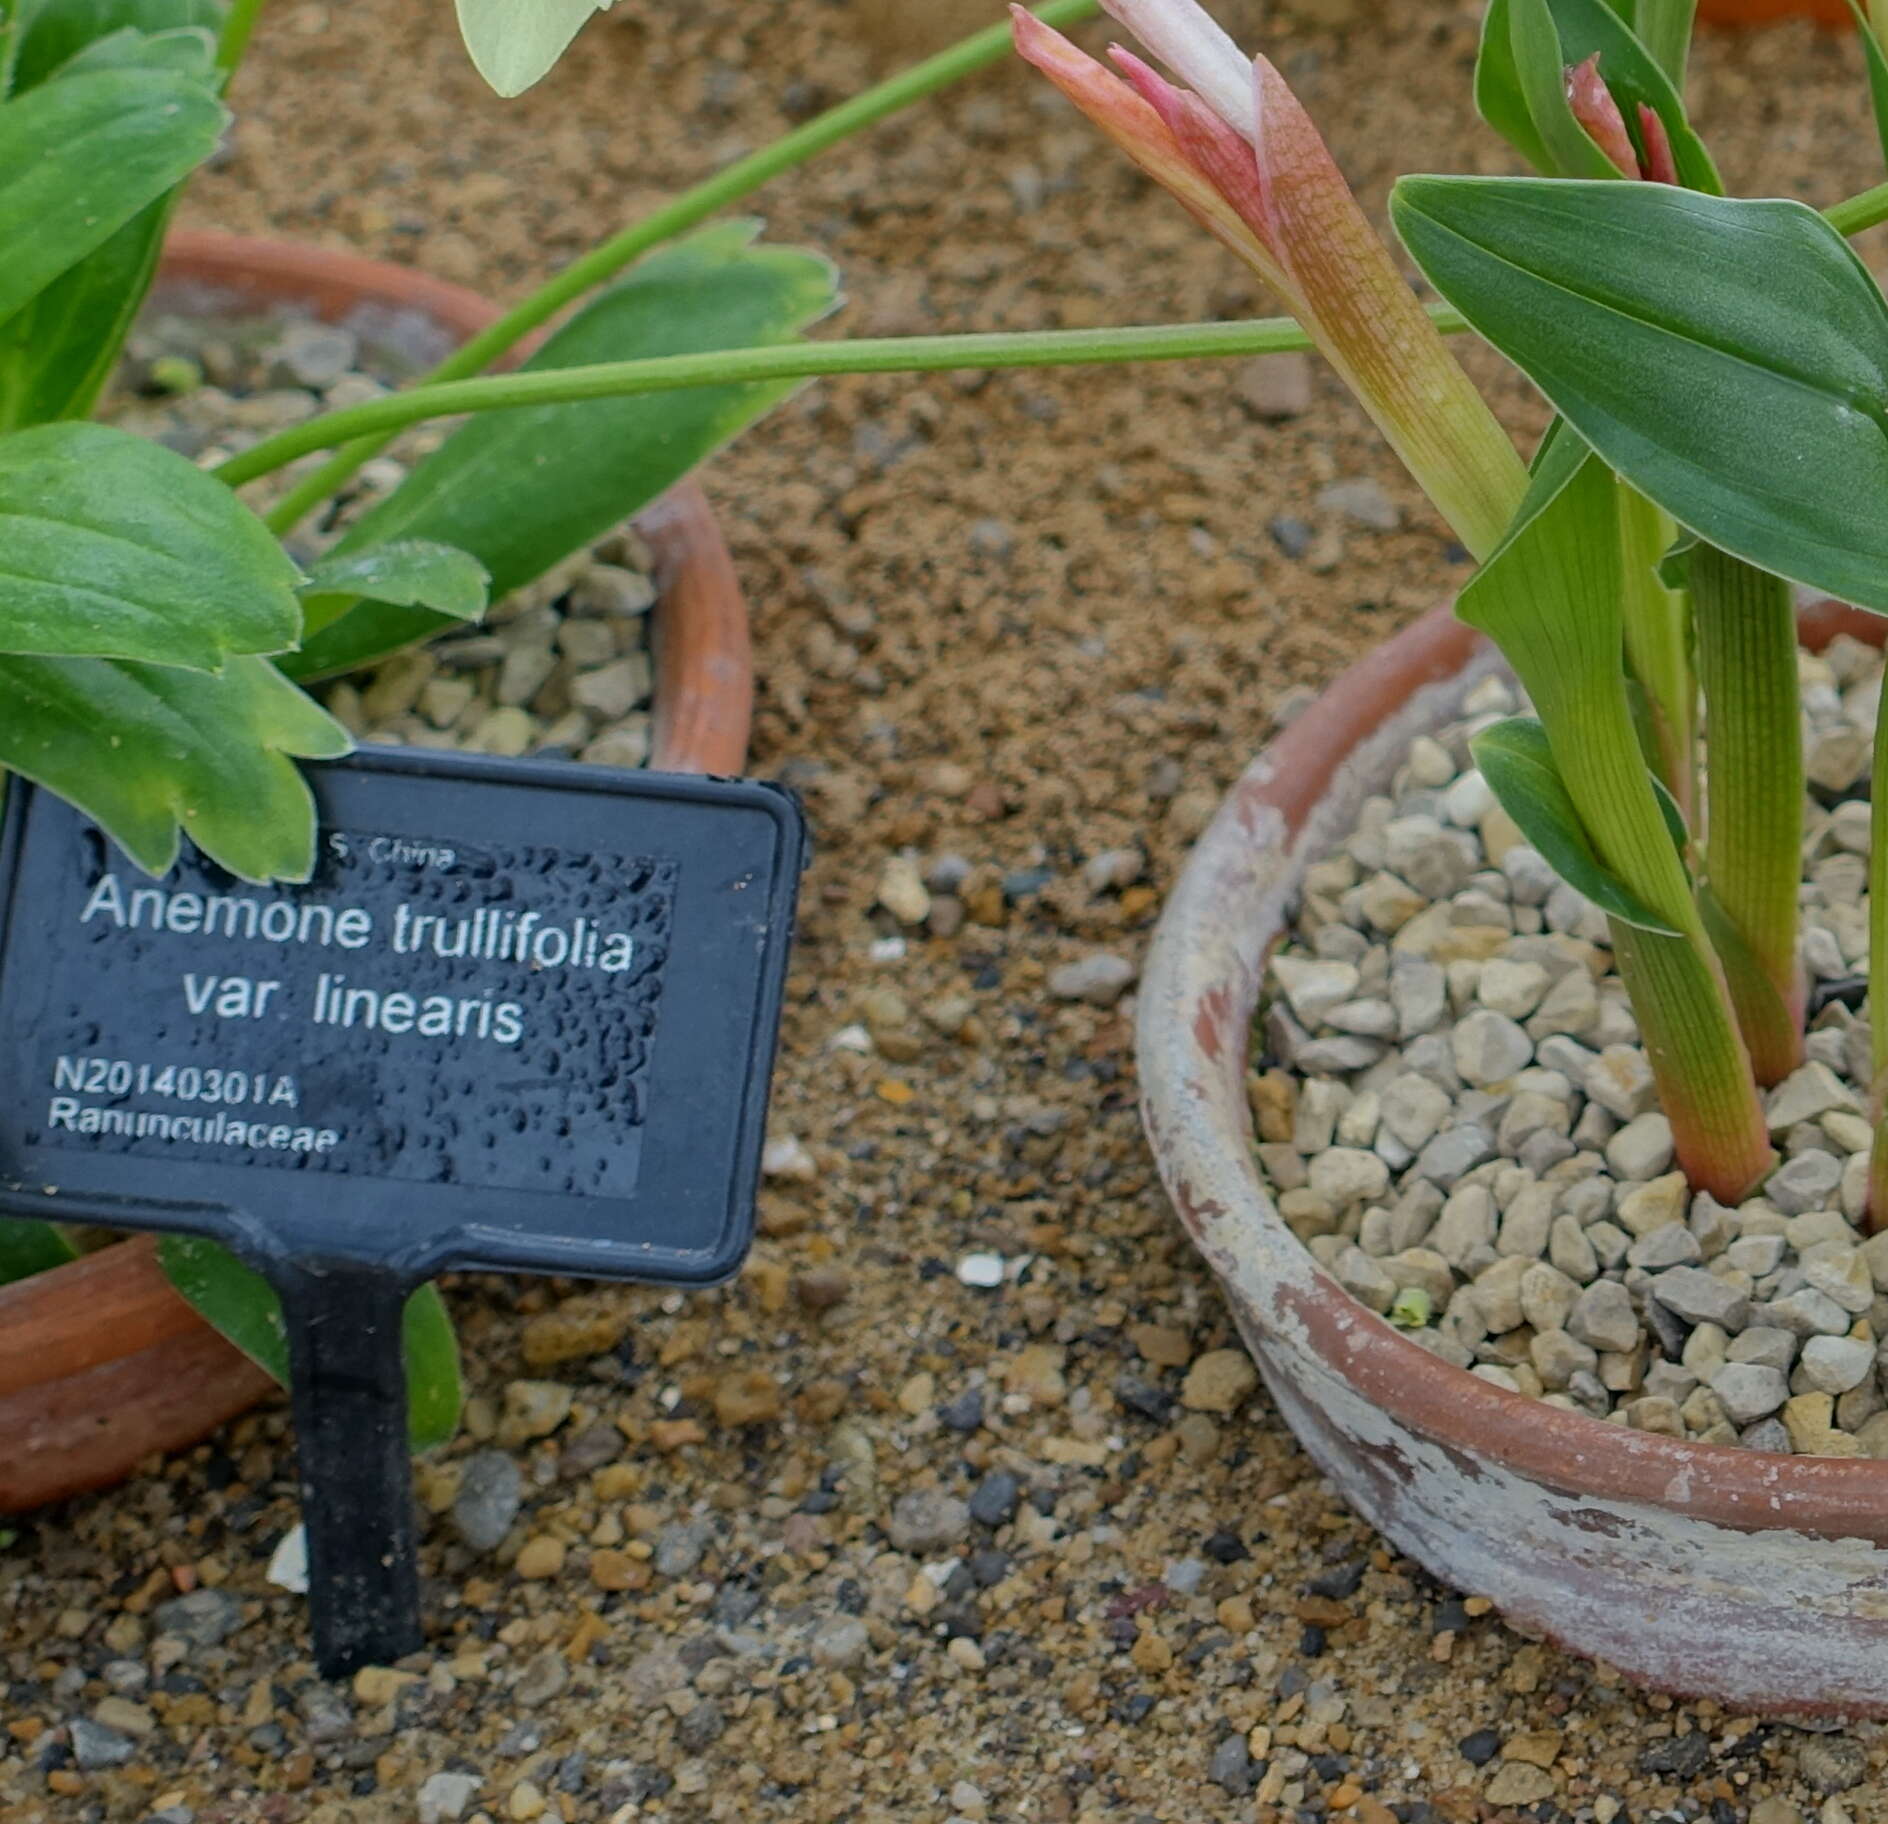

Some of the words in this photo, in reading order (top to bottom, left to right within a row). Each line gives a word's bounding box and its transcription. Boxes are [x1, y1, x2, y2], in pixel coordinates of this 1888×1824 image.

[368, 836, 456, 872] China
[81, 873, 371, 950] Anemone
[393, 903, 634, 973] trullifolia
[182, 973, 278, 1018] var
[313, 975, 525, 1044] linearis
[54, 1056, 297, 1106] N20140301A
[48, 1098, 340, 1154] Ranunculaceae
